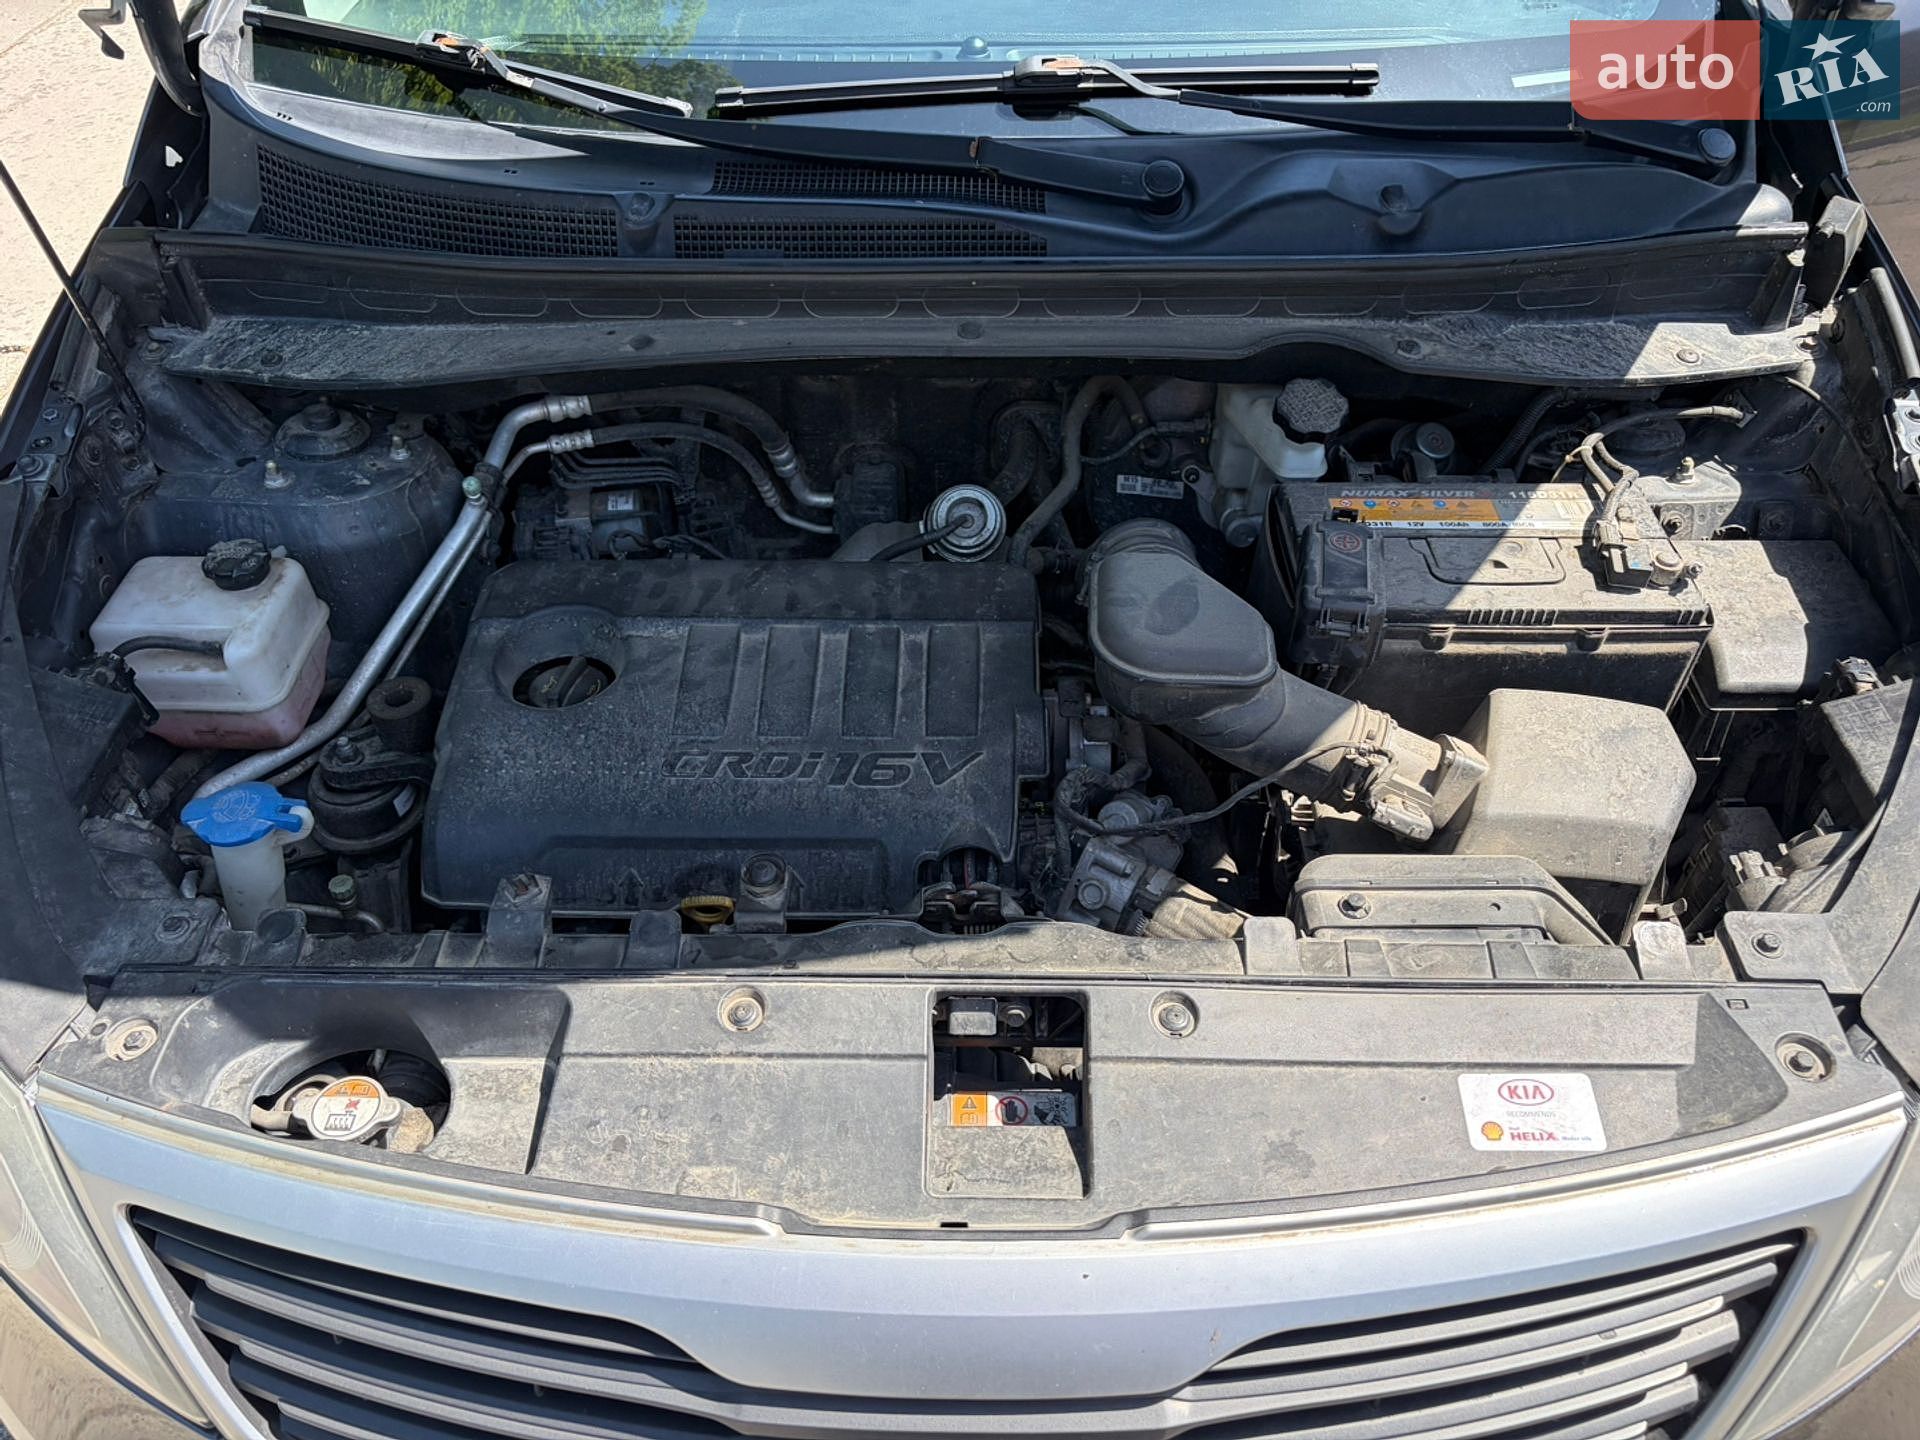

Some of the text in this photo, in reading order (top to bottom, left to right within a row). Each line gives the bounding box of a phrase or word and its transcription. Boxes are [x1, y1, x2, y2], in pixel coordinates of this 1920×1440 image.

[1340, 489, 1409, 498] NUMAX
[1421, 489, 1475, 498] SILVER
[1507, 1085, 1546, 1100] KIA
[1509, 1130, 1559, 1142] HELIX
